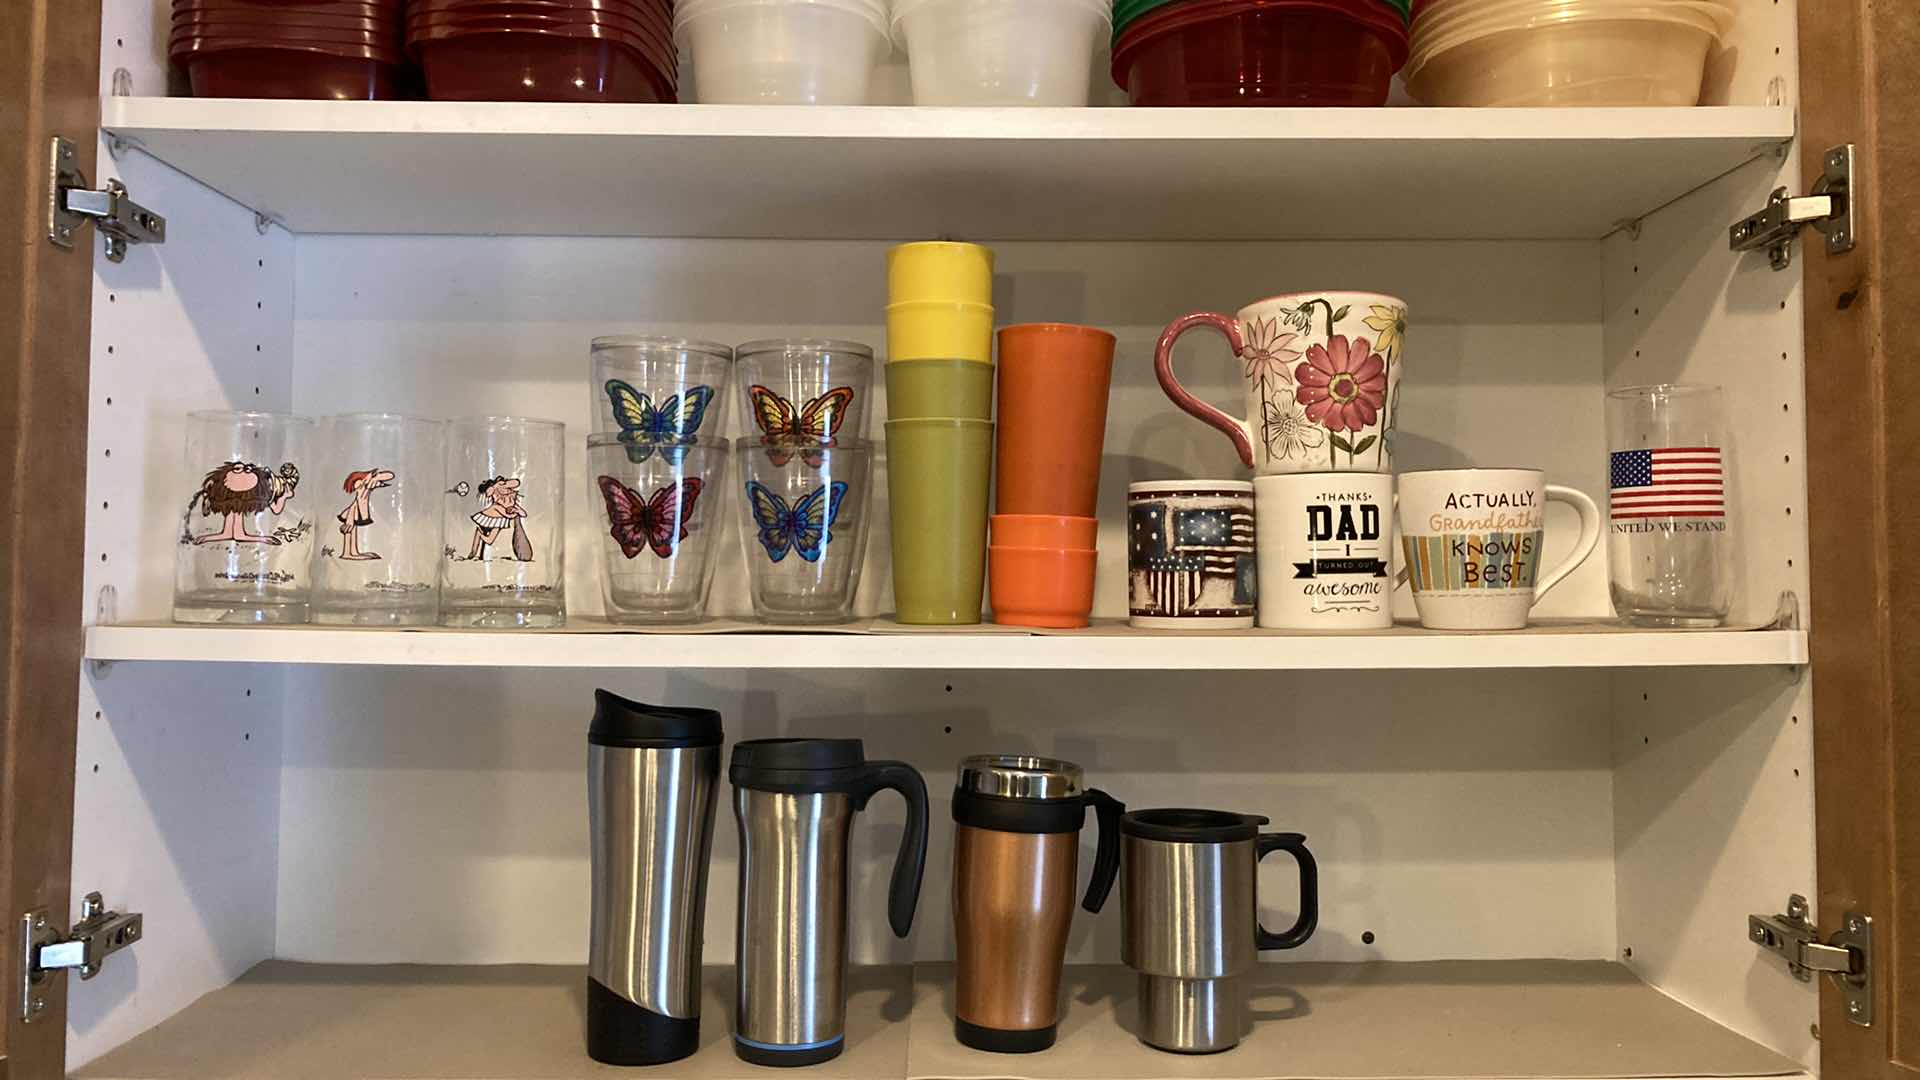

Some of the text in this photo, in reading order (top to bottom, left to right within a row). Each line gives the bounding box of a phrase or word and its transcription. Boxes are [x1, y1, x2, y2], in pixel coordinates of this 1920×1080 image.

[1321, 492, 1368, 502] THANKS
[1445, 490, 1537, 509] ACTUALLY,
[1306, 504, 1380, 541] DAD
[1659, 521, 1682, 533] WE
[1685, 520, 1726, 532] STAND
[1345, 544, 1350, 556] I
[1452, 537, 1532, 557] KNOWS
[1303, 581, 1382, 596] awesome
